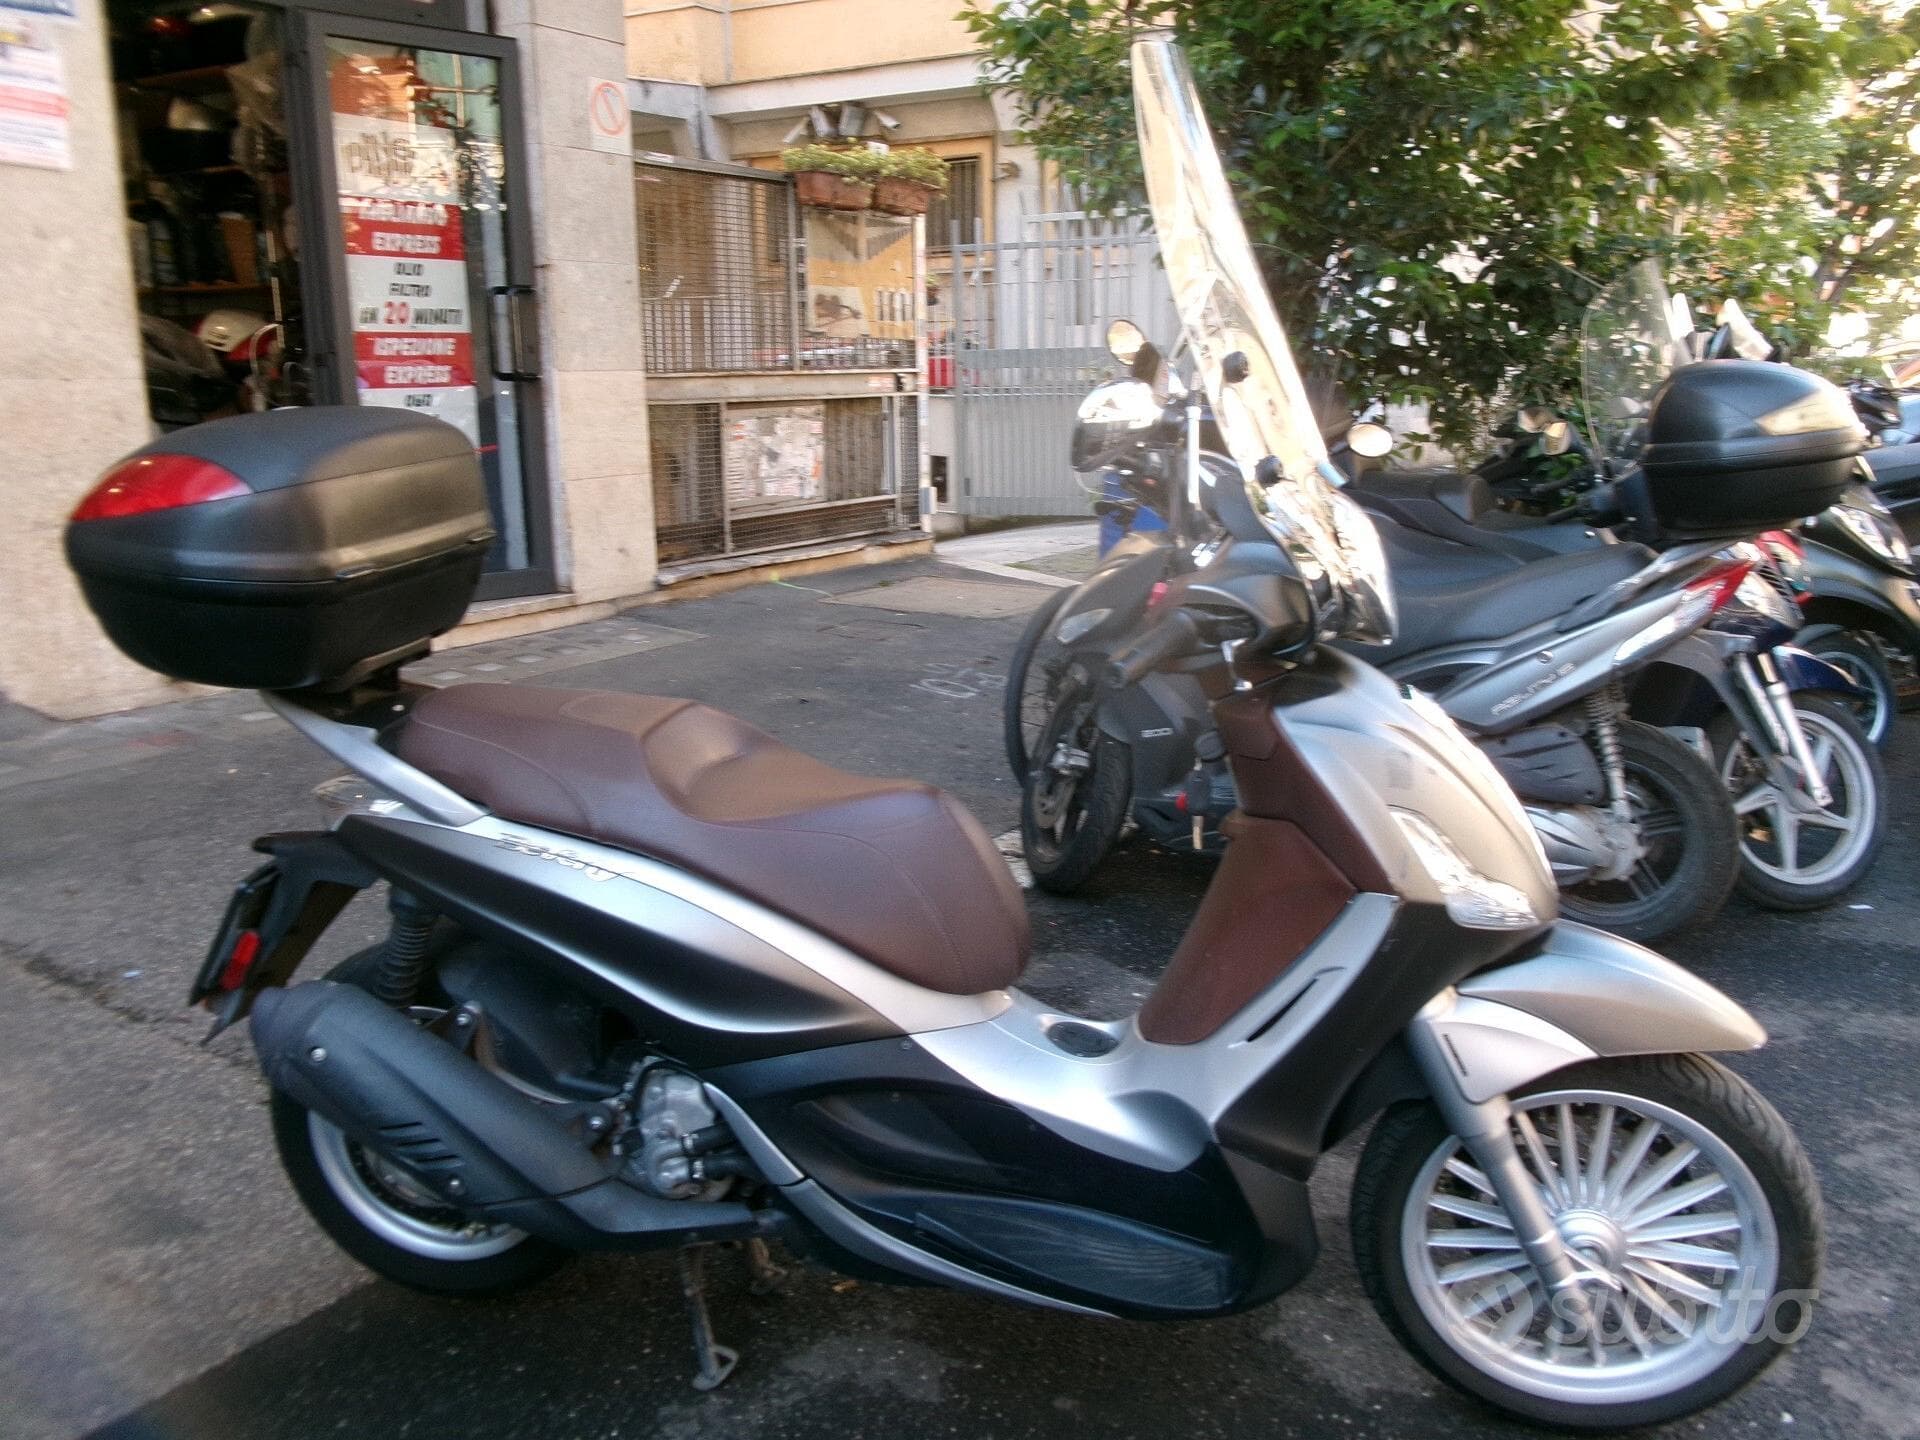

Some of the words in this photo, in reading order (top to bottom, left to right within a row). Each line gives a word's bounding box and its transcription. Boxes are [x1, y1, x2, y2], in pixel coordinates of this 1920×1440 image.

[394, 262, 424, 276] OLIO
[388, 282, 432, 297] FILTRO
[384, 300, 410, 325] 20
[413, 307, 464, 324] MINUTI
[383, 365, 453, 385] EXPRESS
